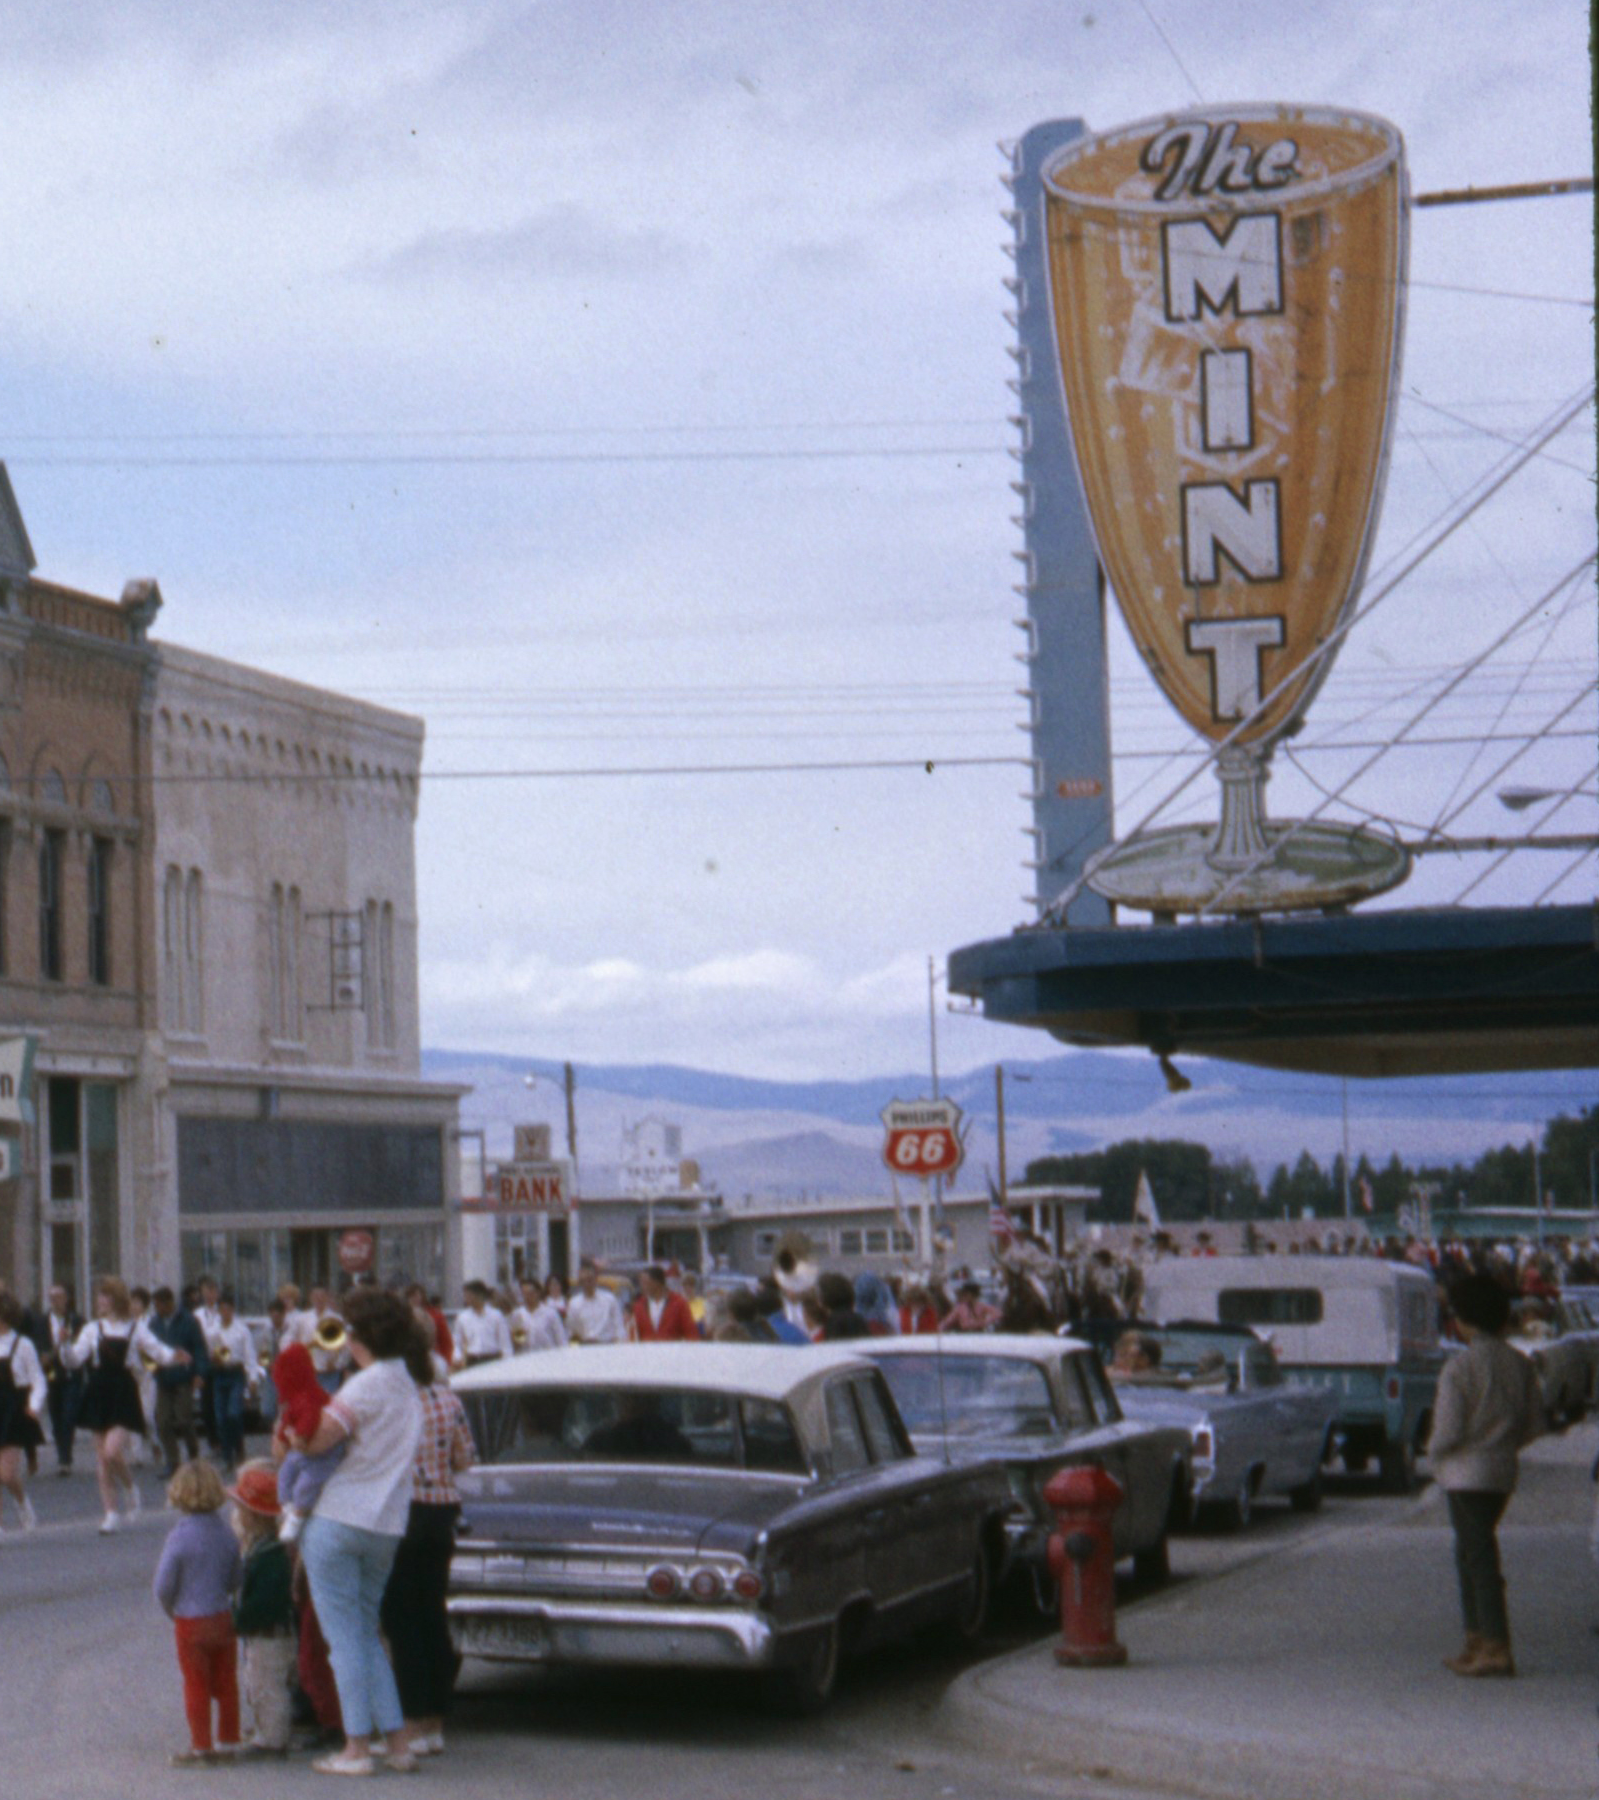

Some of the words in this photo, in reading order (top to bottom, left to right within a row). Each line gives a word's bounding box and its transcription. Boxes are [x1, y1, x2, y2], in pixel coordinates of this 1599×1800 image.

[1140, 121, 1303, 201] The
[1160, 210, 1286, 725] MINT
[891, 1108, 948, 1125] PHILLIPS
[896, 1133, 947, 1166] 66
[501, 1176, 563, 1206] BANK
